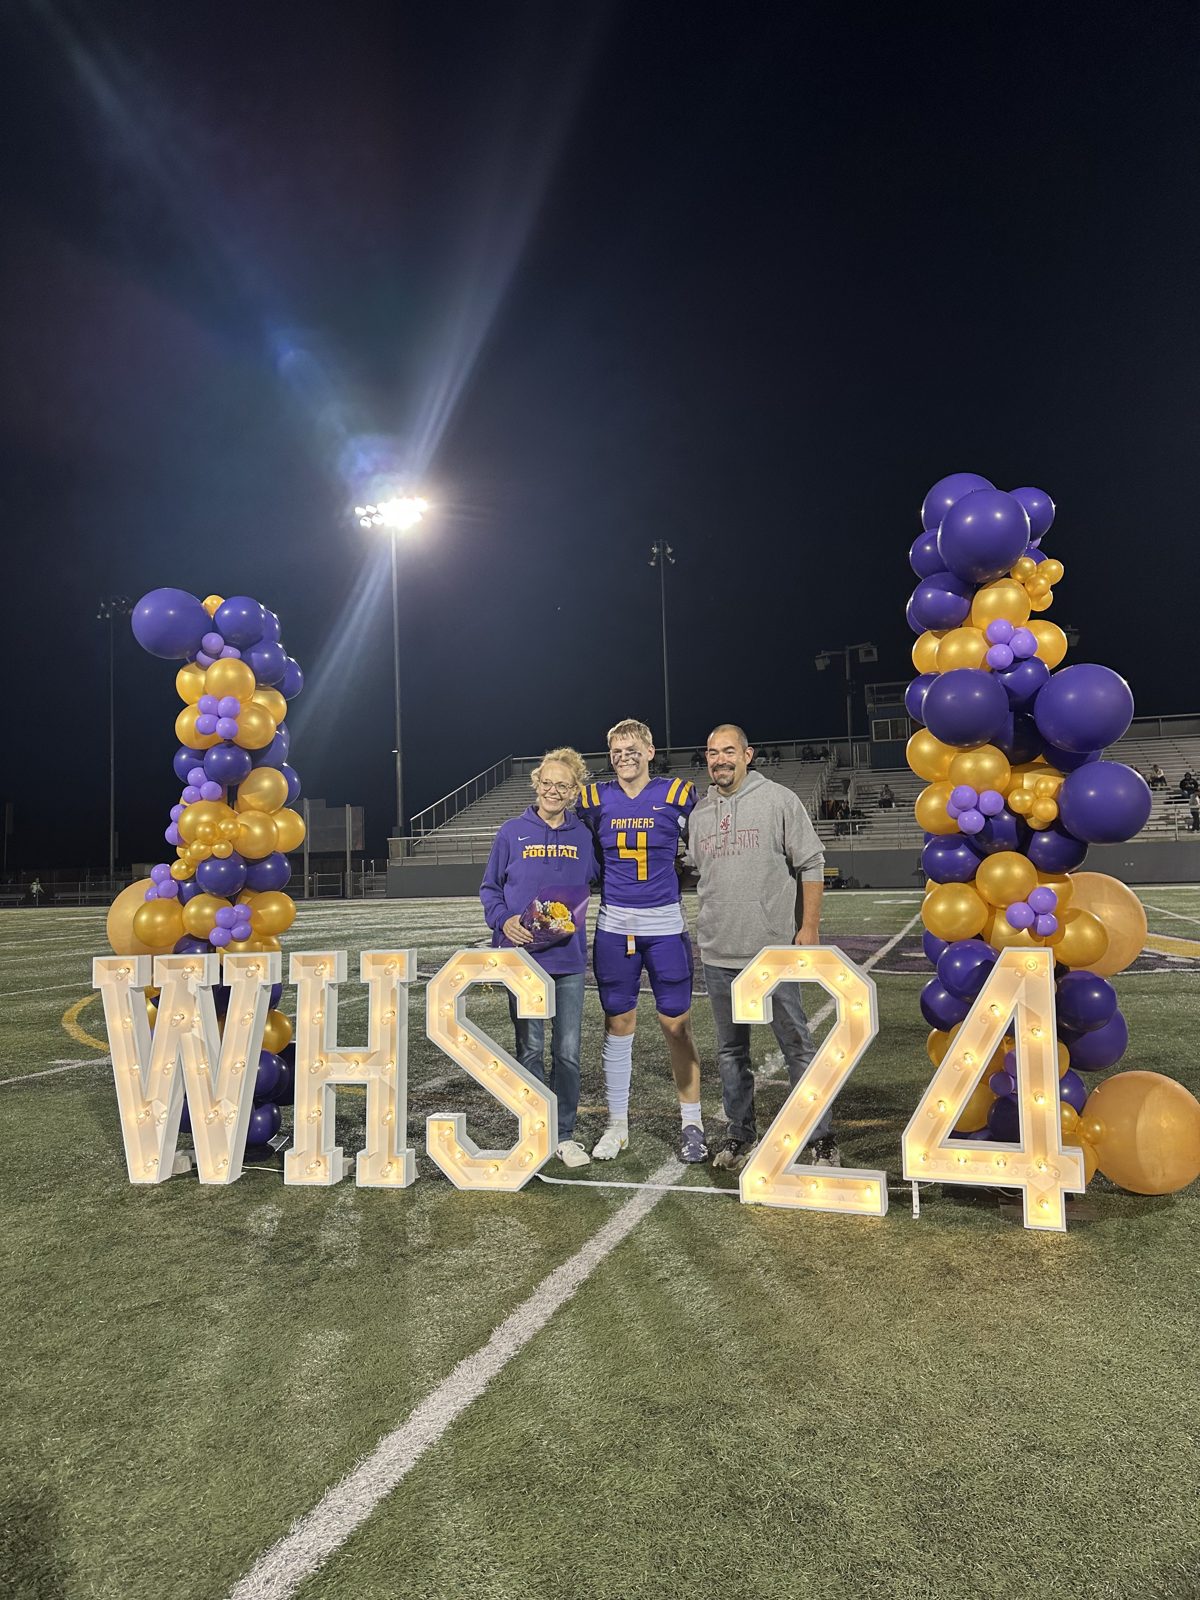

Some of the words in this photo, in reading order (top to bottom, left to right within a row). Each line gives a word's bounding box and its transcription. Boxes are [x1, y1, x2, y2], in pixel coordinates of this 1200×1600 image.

[611, 818, 654, 829] PANTHERS
[617, 831, 648, 881] 4
[93, 948, 558, 1191] WHS
[731, 945, 1085, 1232] 24
